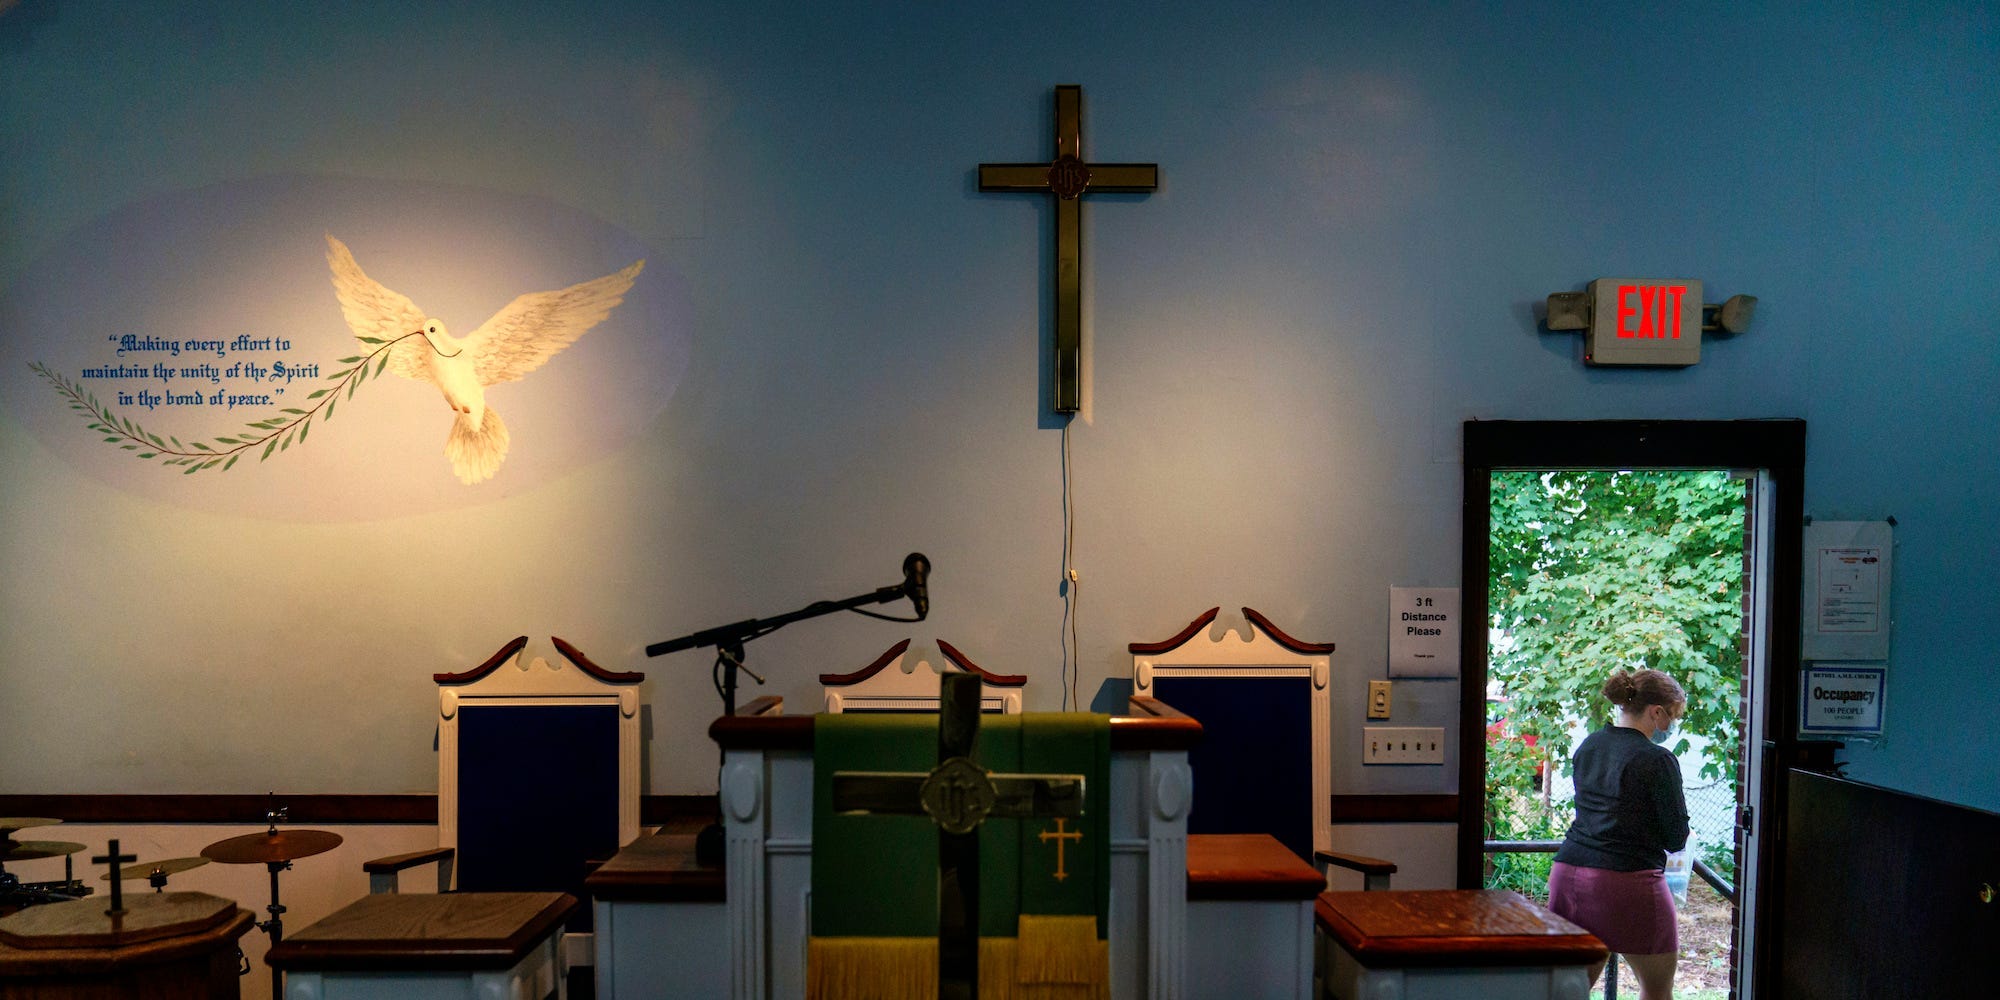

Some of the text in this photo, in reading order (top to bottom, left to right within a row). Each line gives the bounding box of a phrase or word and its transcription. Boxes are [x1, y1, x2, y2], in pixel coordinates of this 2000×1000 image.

[1617, 286, 1687, 339] EXIT
[185, 338, 225, 358] every
[230, 335, 271, 351] effort
[275, 338, 291, 351] to
[82, 360, 319, 384] maintain the unity of the Spirit
[118, 390, 134, 405] in
[138, 389, 162, 410] the
[166, 389, 204, 405] bond
[209, 388, 226, 405] of
[1416, 597, 1433, 607] 3 ft
[1402, 612, 1447, 621] Distance
[1407, 627, 1441, 636] Please
[1813, 686, 1875, 704] Occupancy
[1837, 707, 1865, 715] PEOPLE
